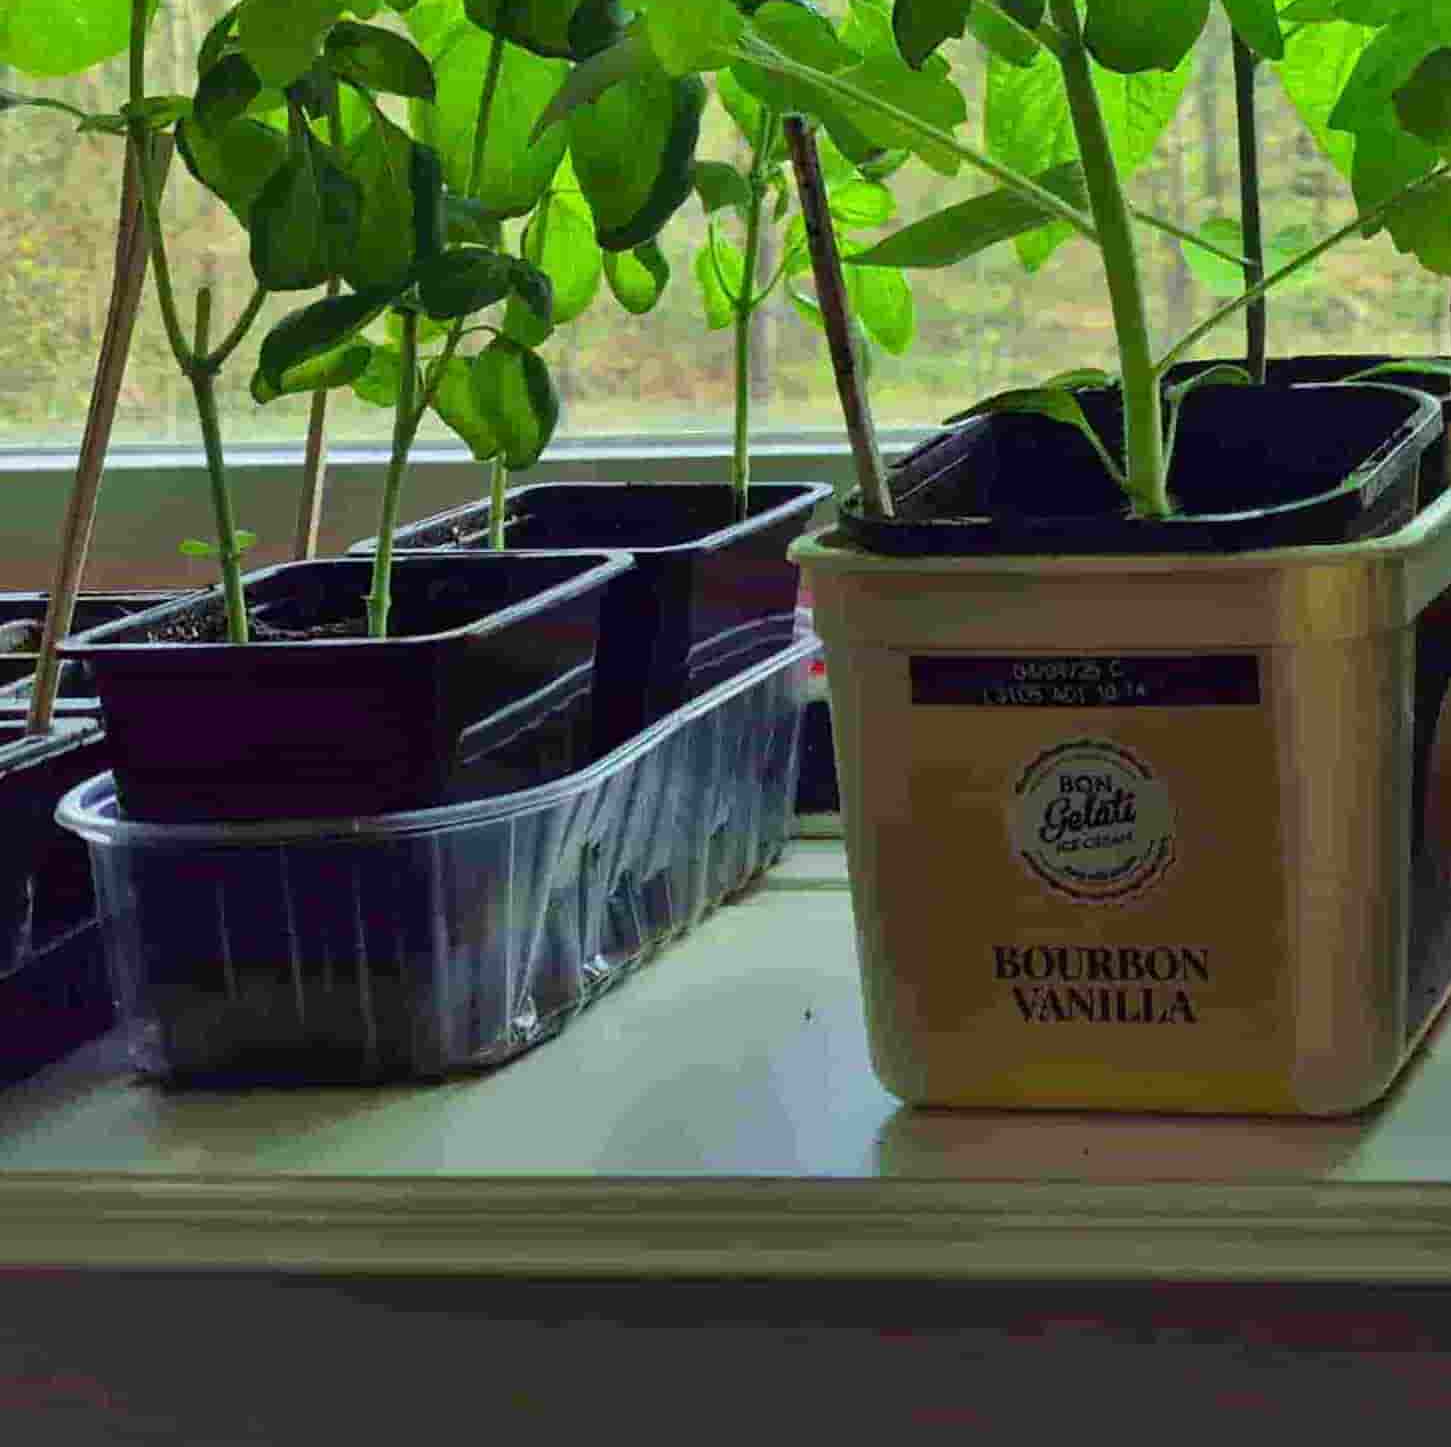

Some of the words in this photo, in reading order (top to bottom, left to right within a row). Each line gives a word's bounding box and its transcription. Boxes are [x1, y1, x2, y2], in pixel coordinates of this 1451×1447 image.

[1060, 774, 1112, 794] BON
[1040, 788, 1137, 844] Gelati
[993, 946, 1209, 981] BOURBON
[1011, 986, 1197, 1024] VANILLA
